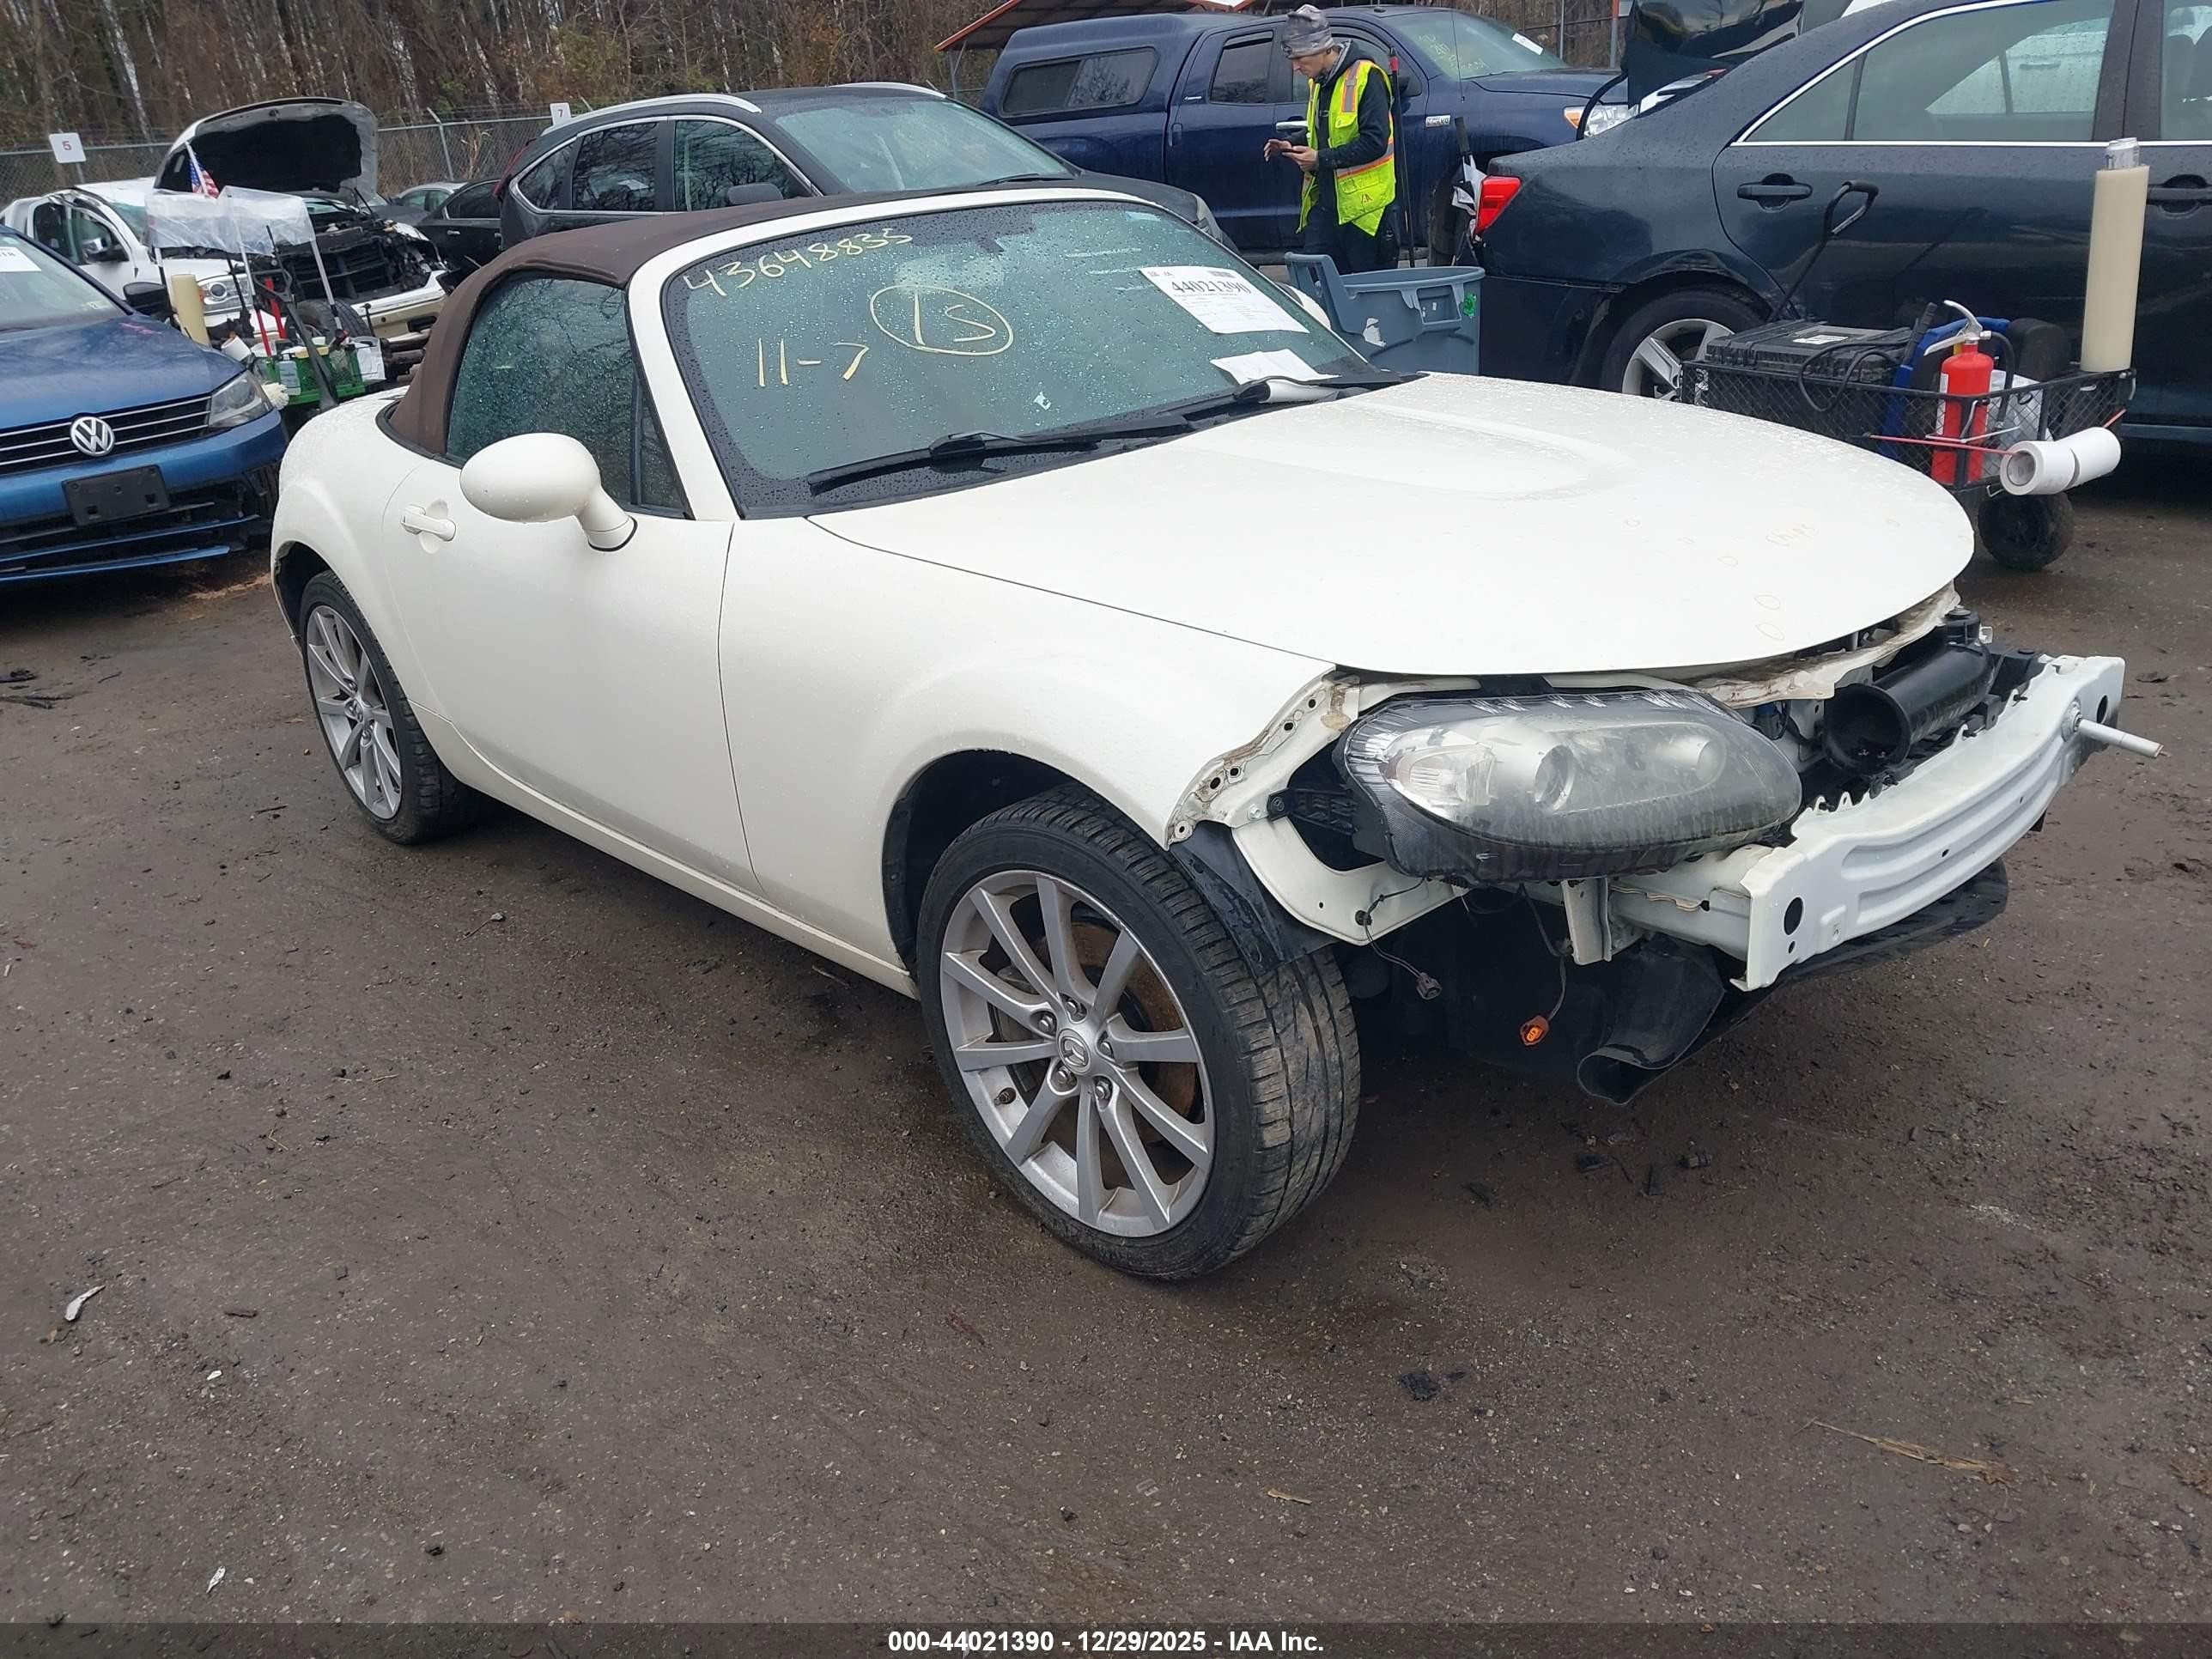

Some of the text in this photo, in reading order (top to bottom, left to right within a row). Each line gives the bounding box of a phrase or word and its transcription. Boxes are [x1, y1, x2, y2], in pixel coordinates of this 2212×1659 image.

[62, 140, 72, 151] 5
[683, 228, 914, 297] 43648835
[1170, 280, 1253, 295] 44021390
